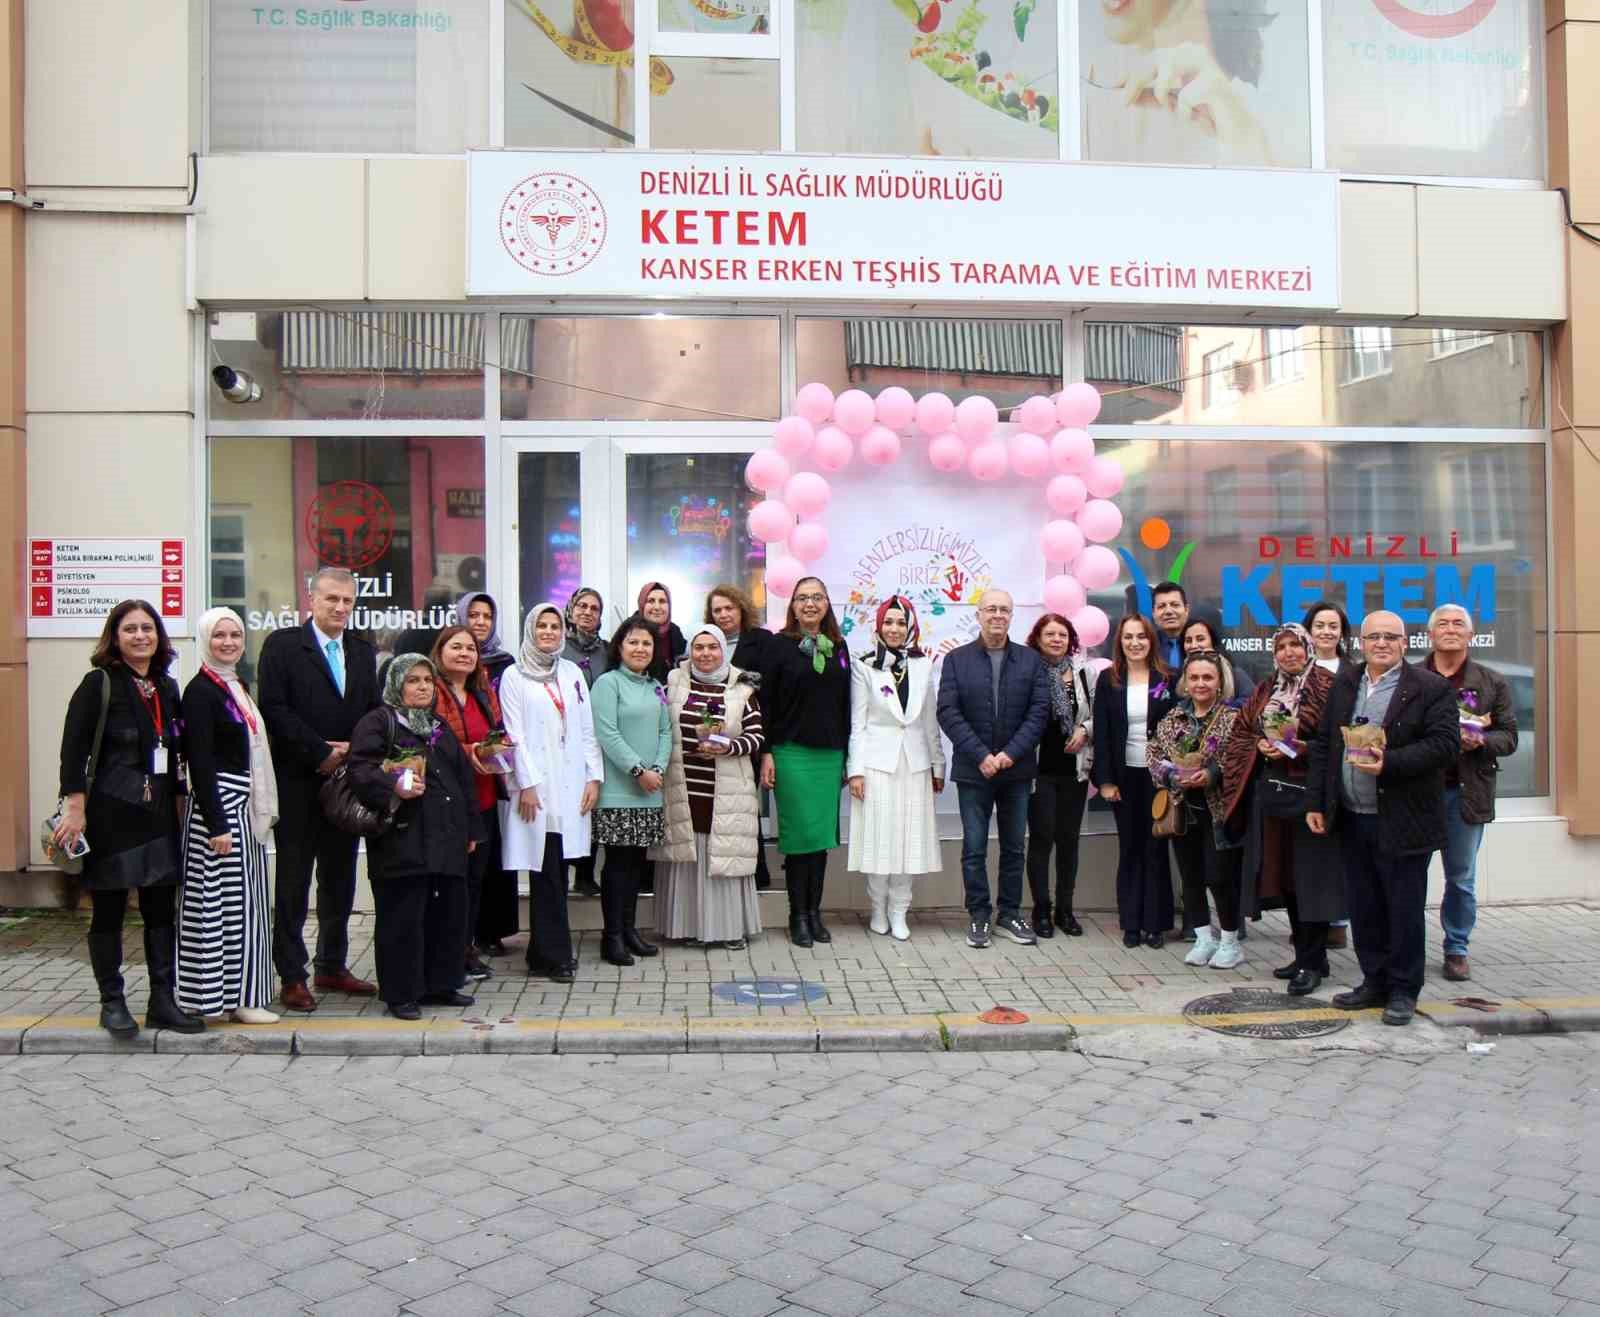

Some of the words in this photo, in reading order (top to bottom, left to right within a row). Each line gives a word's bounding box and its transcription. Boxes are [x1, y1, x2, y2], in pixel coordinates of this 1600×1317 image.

[295, 9, 354, 30] Sağlık
[640, 166, 730, 196] DENİZLİ
[739, 167, 759, 196] İL
[766, 168, 848, 198] SAĞLIK
[855, 169, 1003, 201] MÜDÜRLÜĞÜ
[641, 209, 808, 246] KETEM
[641, 258, 748, 281] KANSER
[758, 259, 843, 283] ERKEN
[853, 257, 941, 288] TEŞHİS
[951, 262, 1060, 286] TARAMA
[1069, 265, 1100, 286] VE
[1110, 260, 1197, 289] EĞİTİM
[1207, 265, 1312, 292] MERKEZİ
[1259, 532, 1458, 558] DENİZLİ
[899, 563, 941, 585] BİRİZ
[1221, 564, 1496, 627] KETEM
